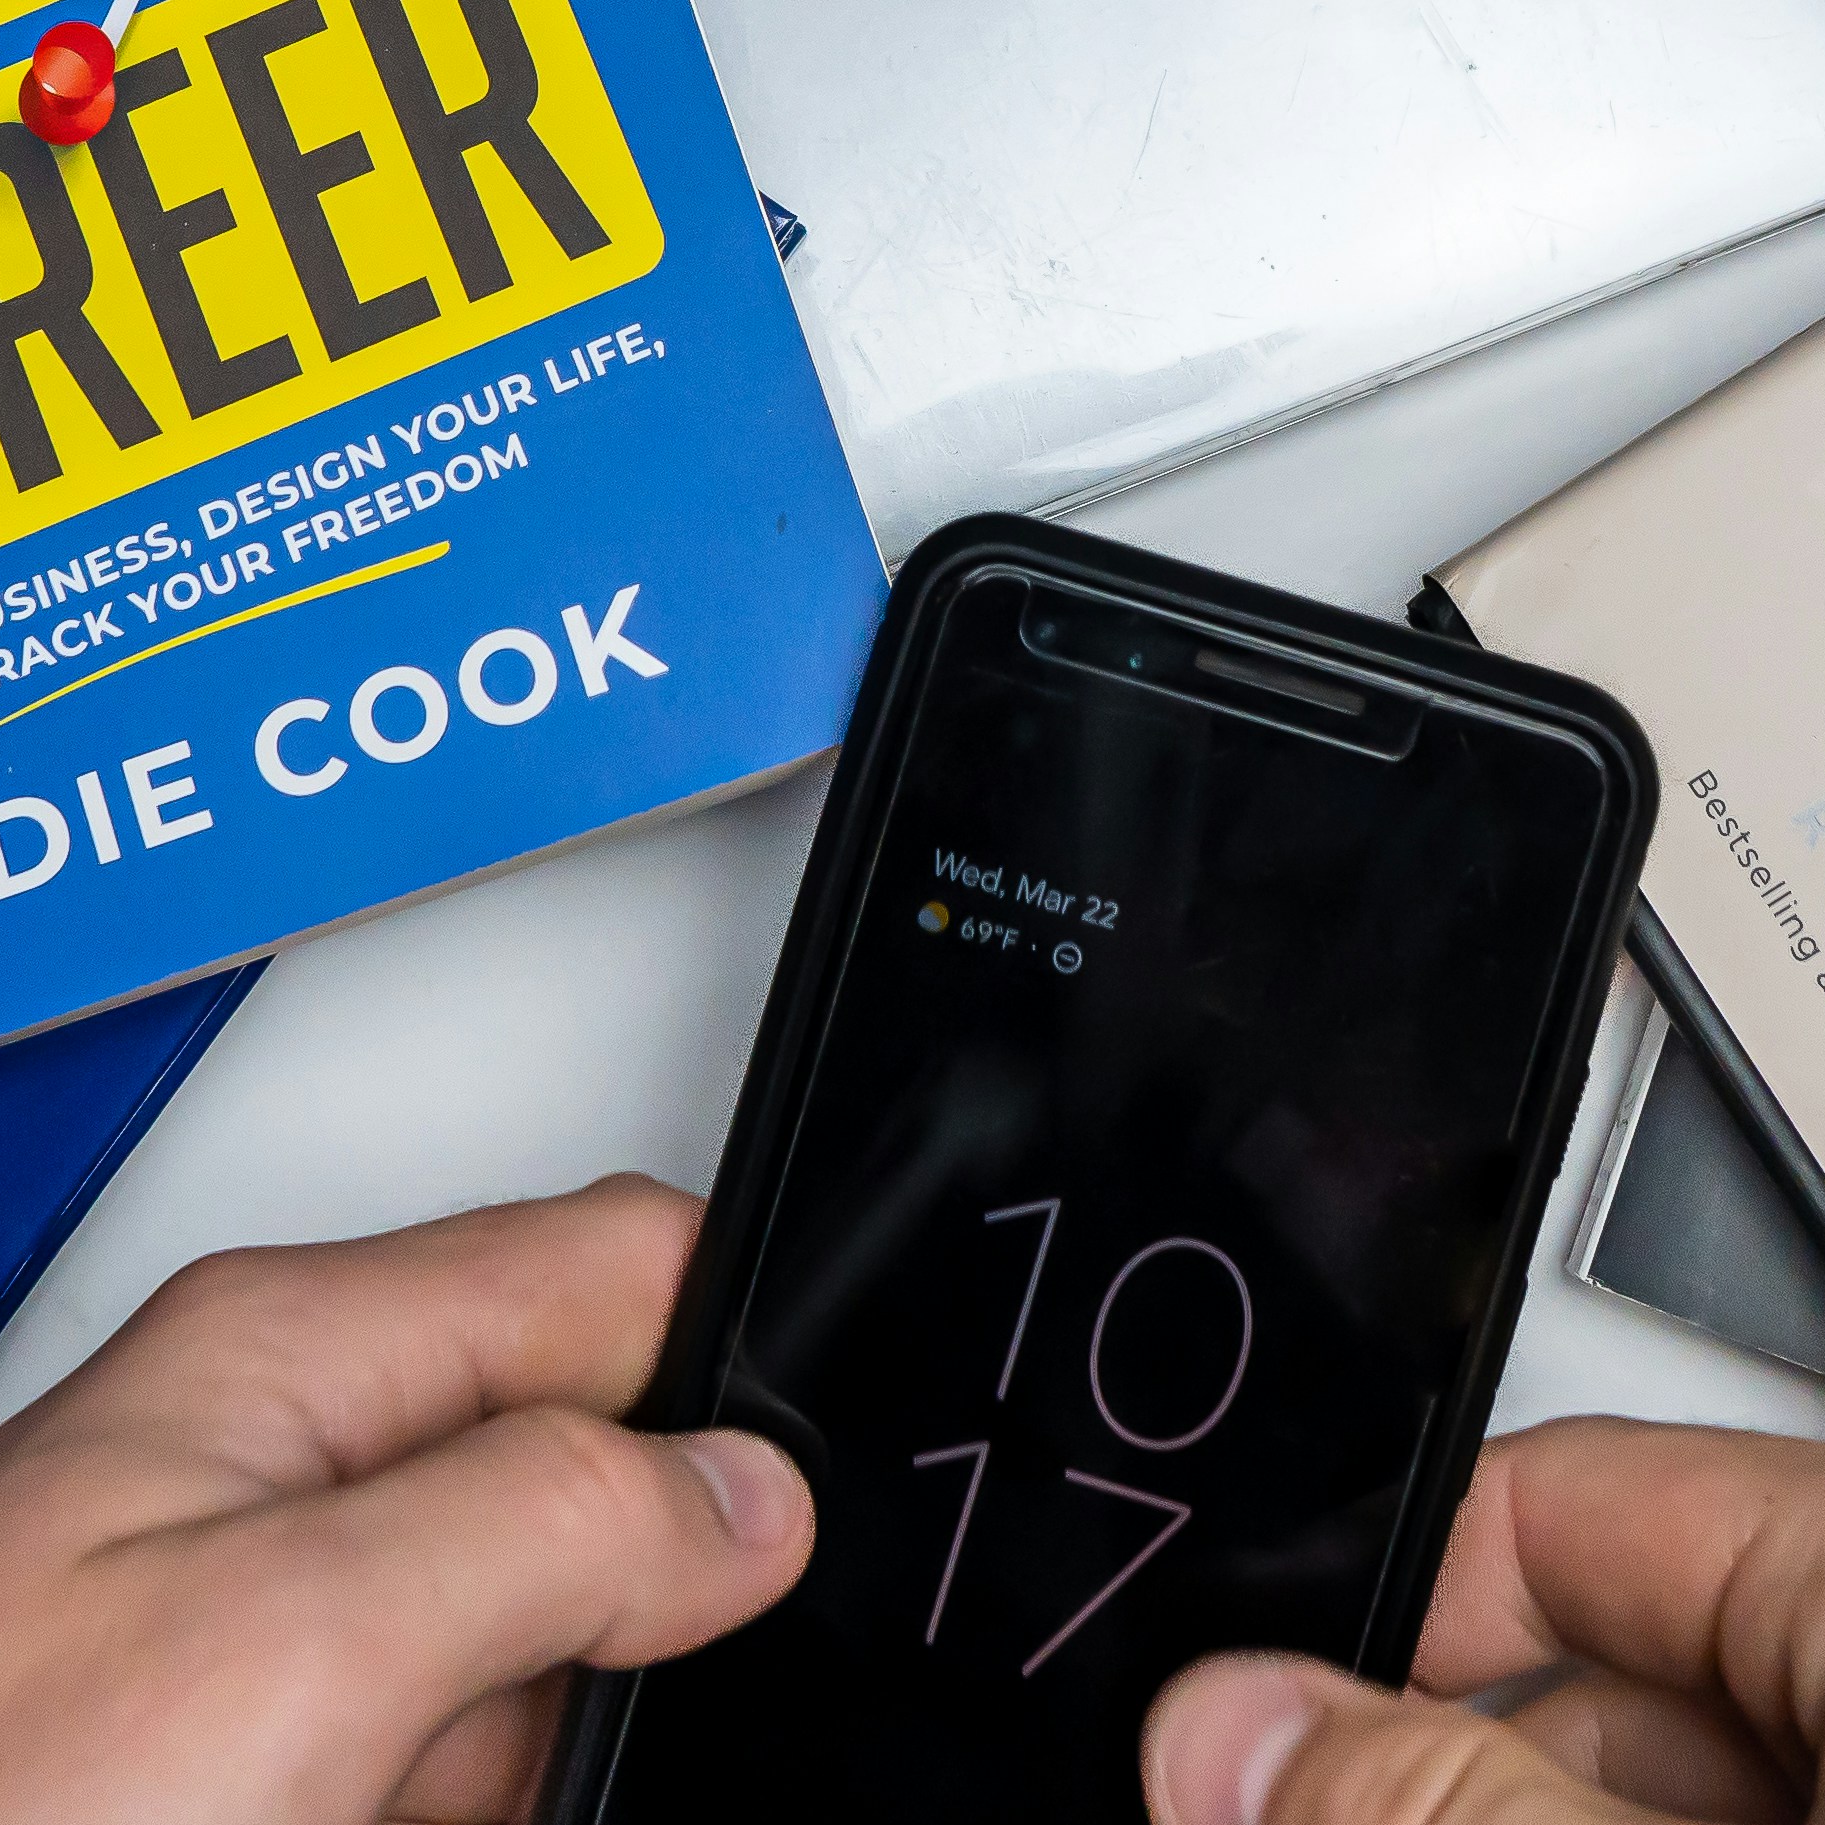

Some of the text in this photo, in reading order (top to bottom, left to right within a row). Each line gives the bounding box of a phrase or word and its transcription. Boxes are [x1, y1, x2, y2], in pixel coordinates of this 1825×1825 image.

[127, 543, 275, 623] YOUR
[282, 433, 528, 563] FREEDOM
[198, 435, 386, 540] DESIGN
[390, 374, 537, 454] YOUR
[544, 324, 664, 393] LIFE,
[255, 584, 669, 796] COOK
[936, 848, 1119, 929] Wed, Mar 22
[960, 917, 1020, 951] 69°F
[1687, 769, 1820, 961] Bestselling
[984, 1198, 1252, 1451] 10
[914, 1440, 1191, 1677] 17
